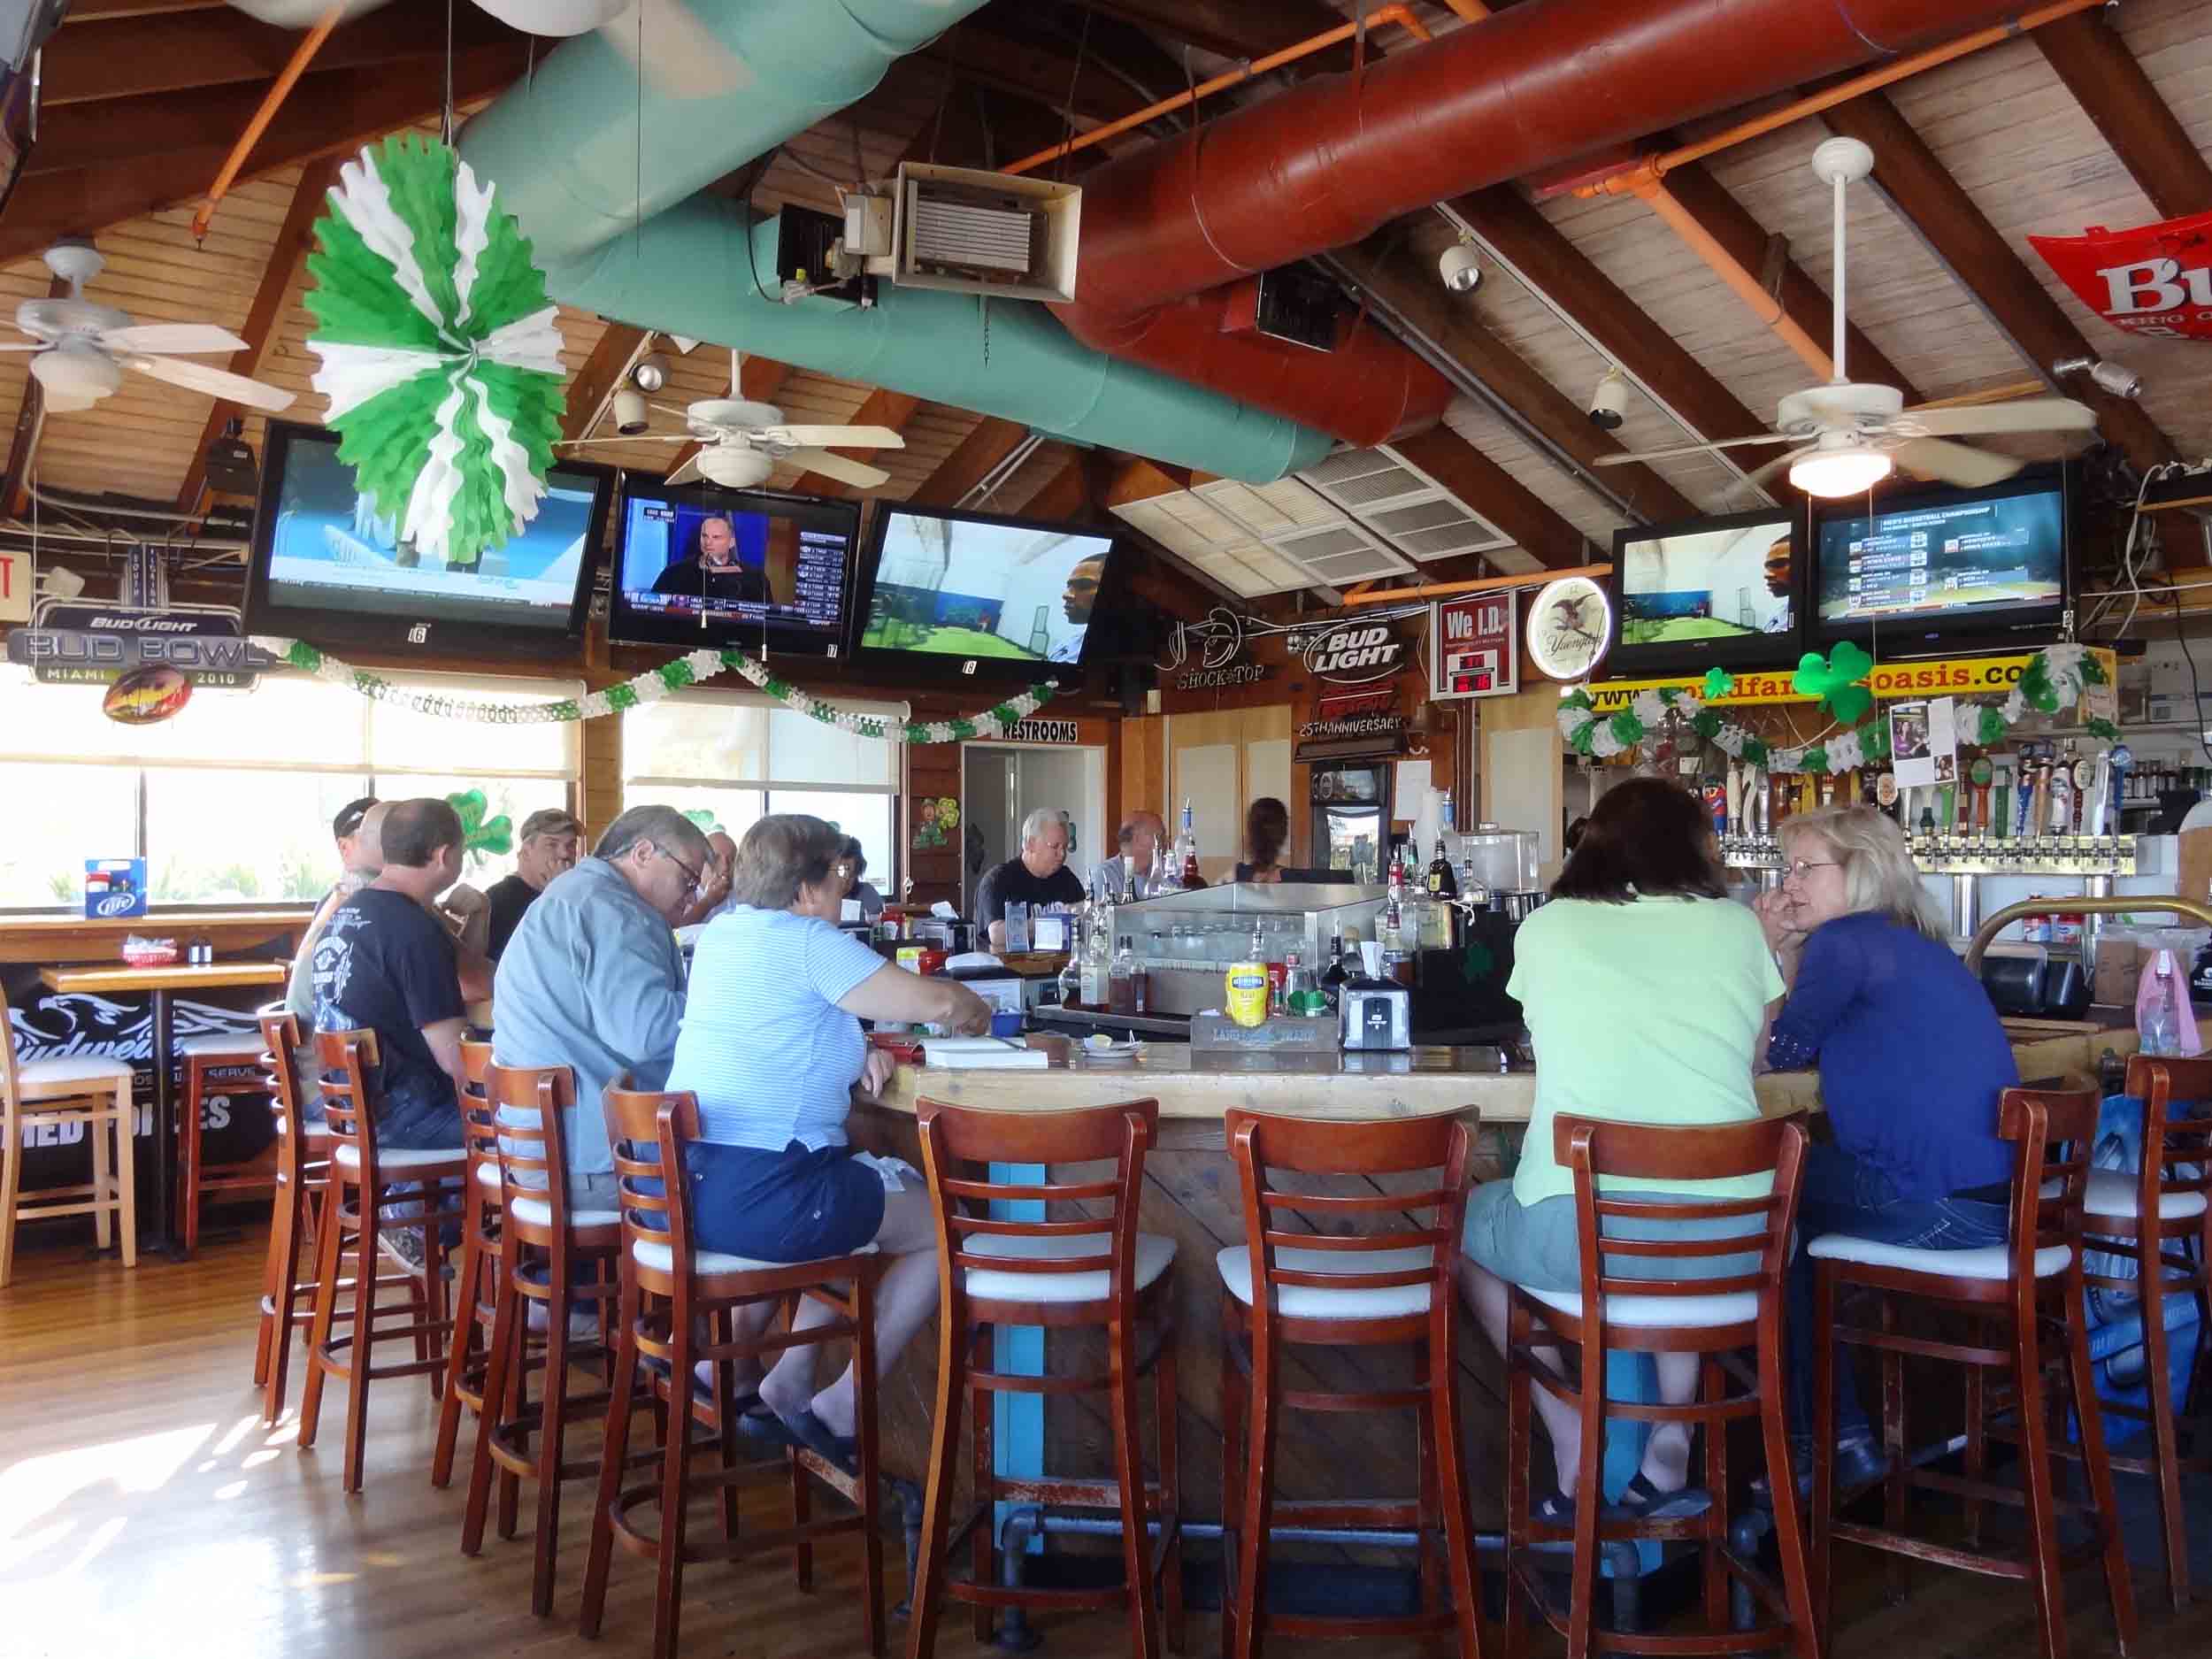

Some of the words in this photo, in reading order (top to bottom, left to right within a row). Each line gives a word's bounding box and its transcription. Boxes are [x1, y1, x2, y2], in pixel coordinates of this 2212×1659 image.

[90, 617, 134, 630] BUD
[142, 620, 197, 632] LIGHT
[1447, 611, 1473, 638] We
[1478, 606, 1504, 635] I.D.
[25, 633, 124, 664] BUD
[137, 635, 266, 667] BOWL
[1327, 626, 1387, 652] BUD
[1313, 644, 1400, 672] LIGHT
[47, 667, 105, 680] MIAMI
[197, 672, 234, 684] 2010
[1177, 670, 1231, 689] SHOCK
[1233, 665, 1264, 682] TOP
[1328, 718, 1402, 735] ANNIVERSARY
